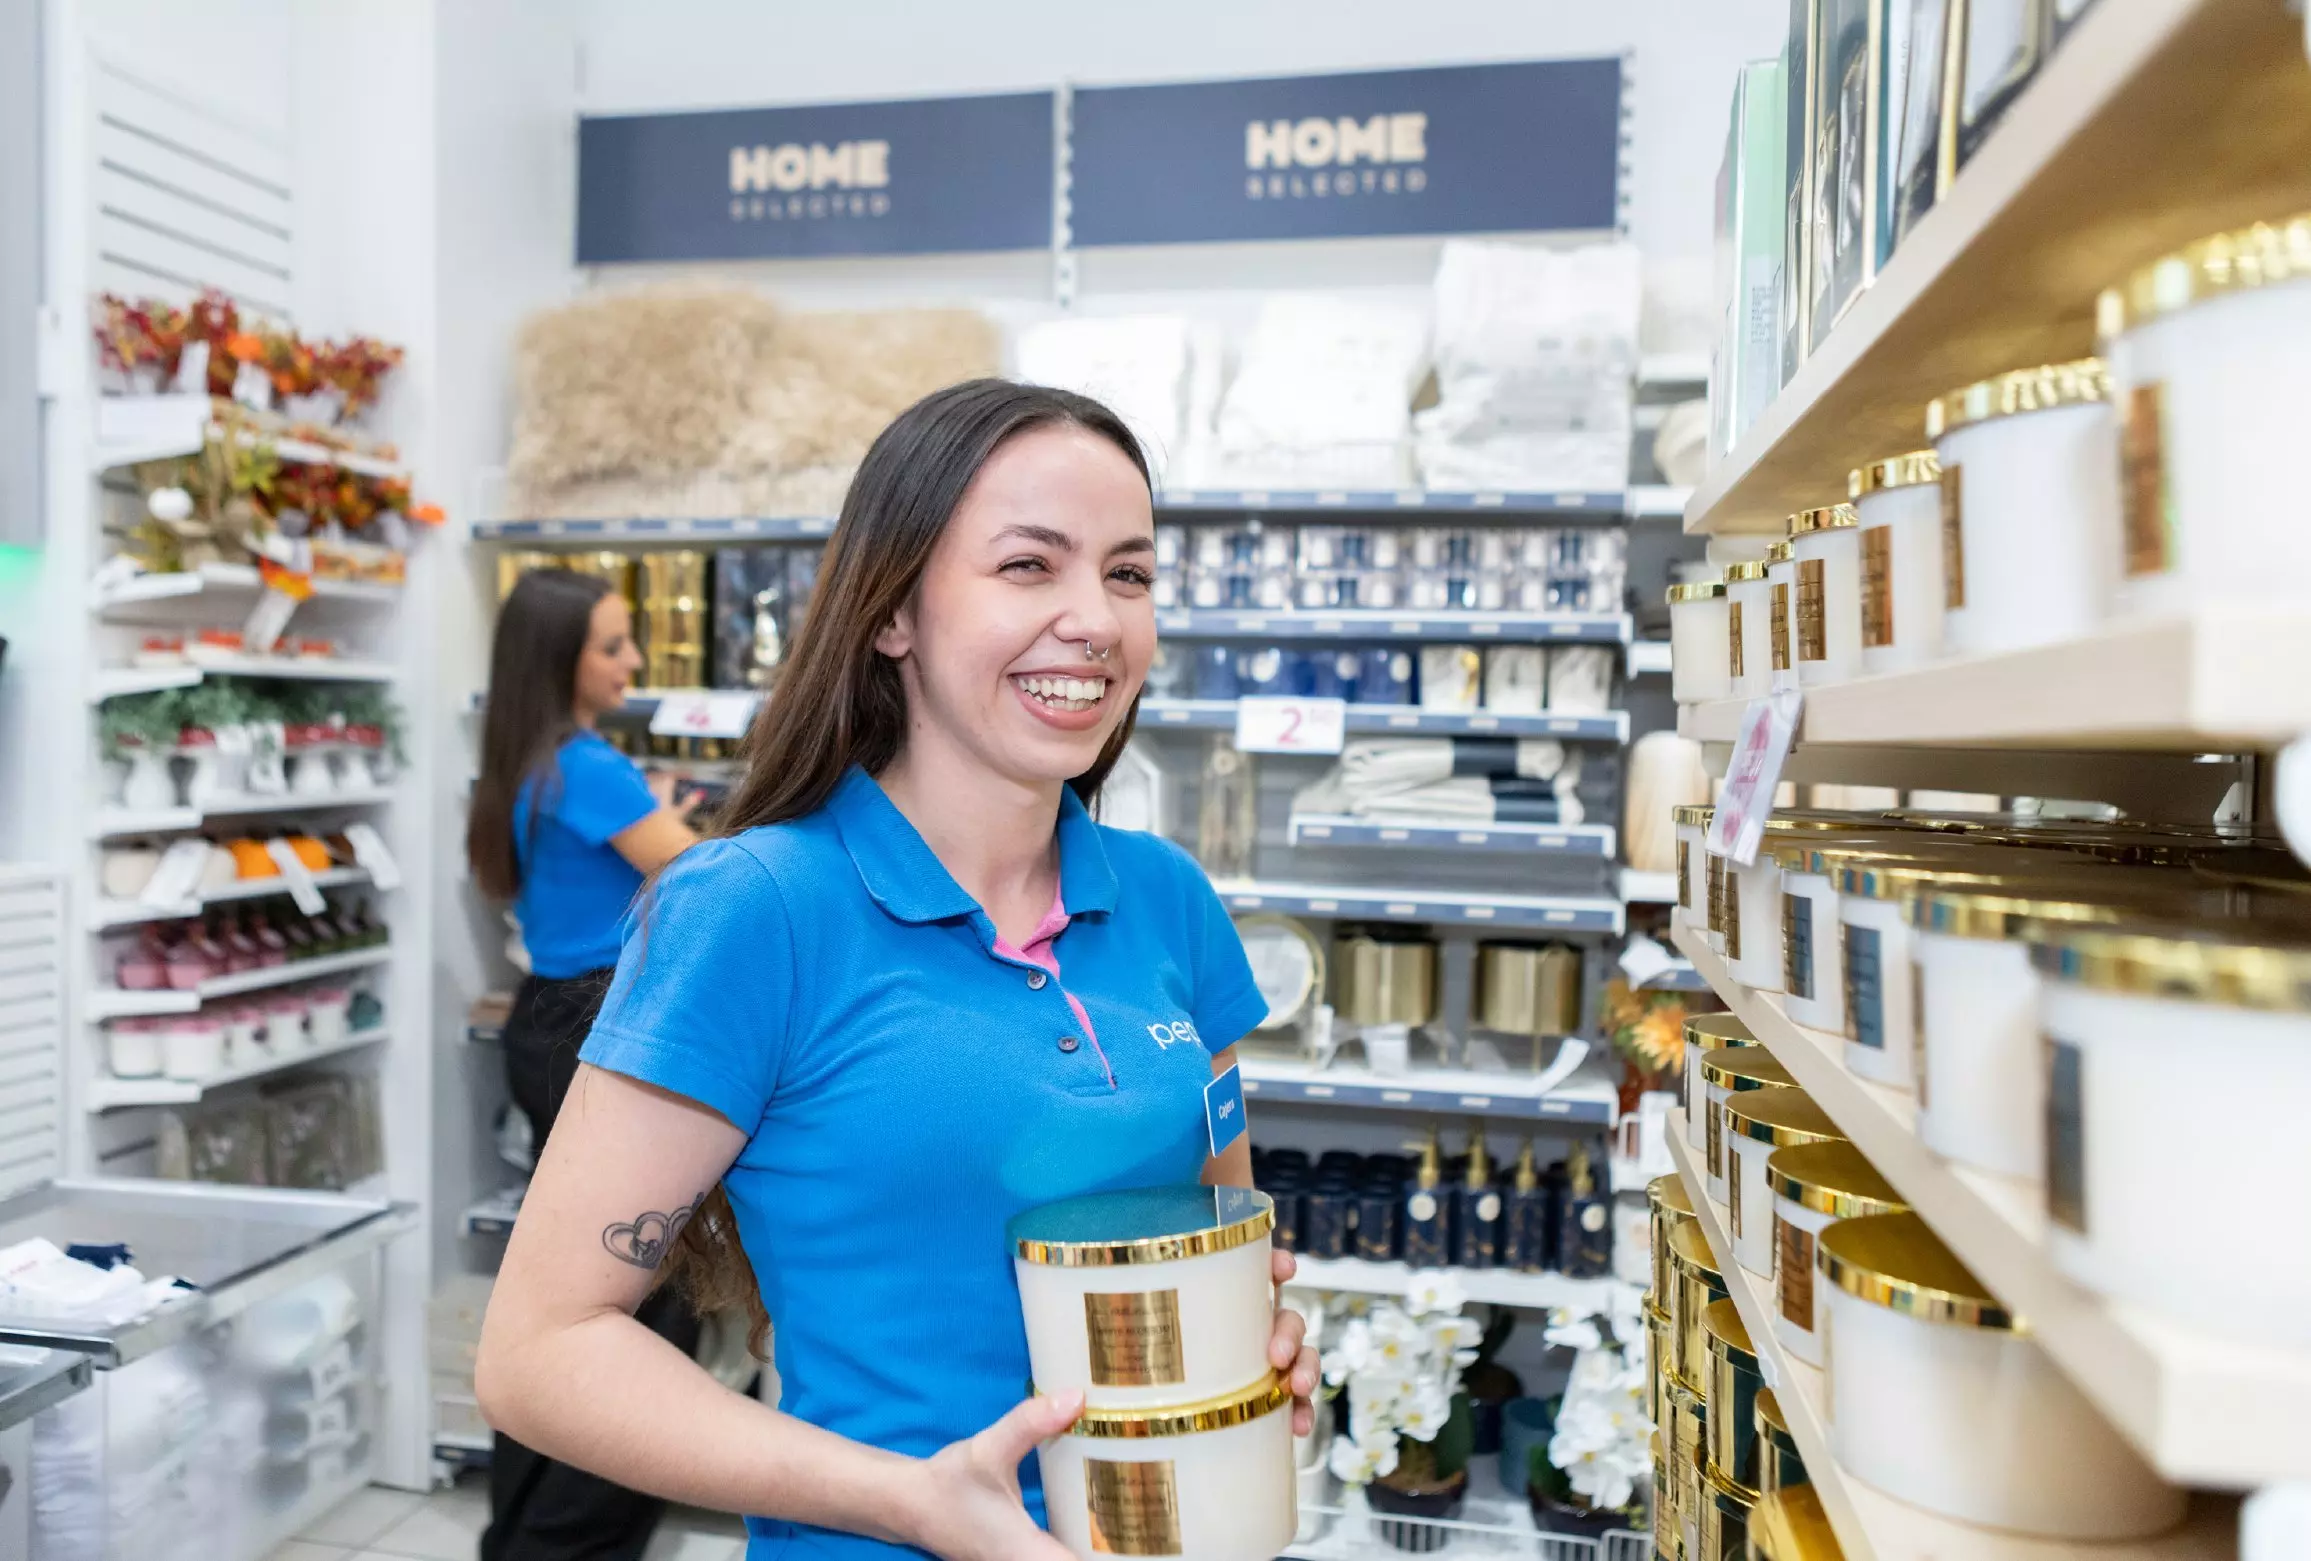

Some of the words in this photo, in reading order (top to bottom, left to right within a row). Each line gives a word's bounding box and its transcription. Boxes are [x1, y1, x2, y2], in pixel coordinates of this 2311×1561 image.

[1246, 113, 1426, 169] HOME
[730, 141, 890, 193] HOME
[1246, 168, 1426, 200] SELECTED
[729, 193, 891, 223] SELECTED
[1278, 706, 1302, 744] 2
